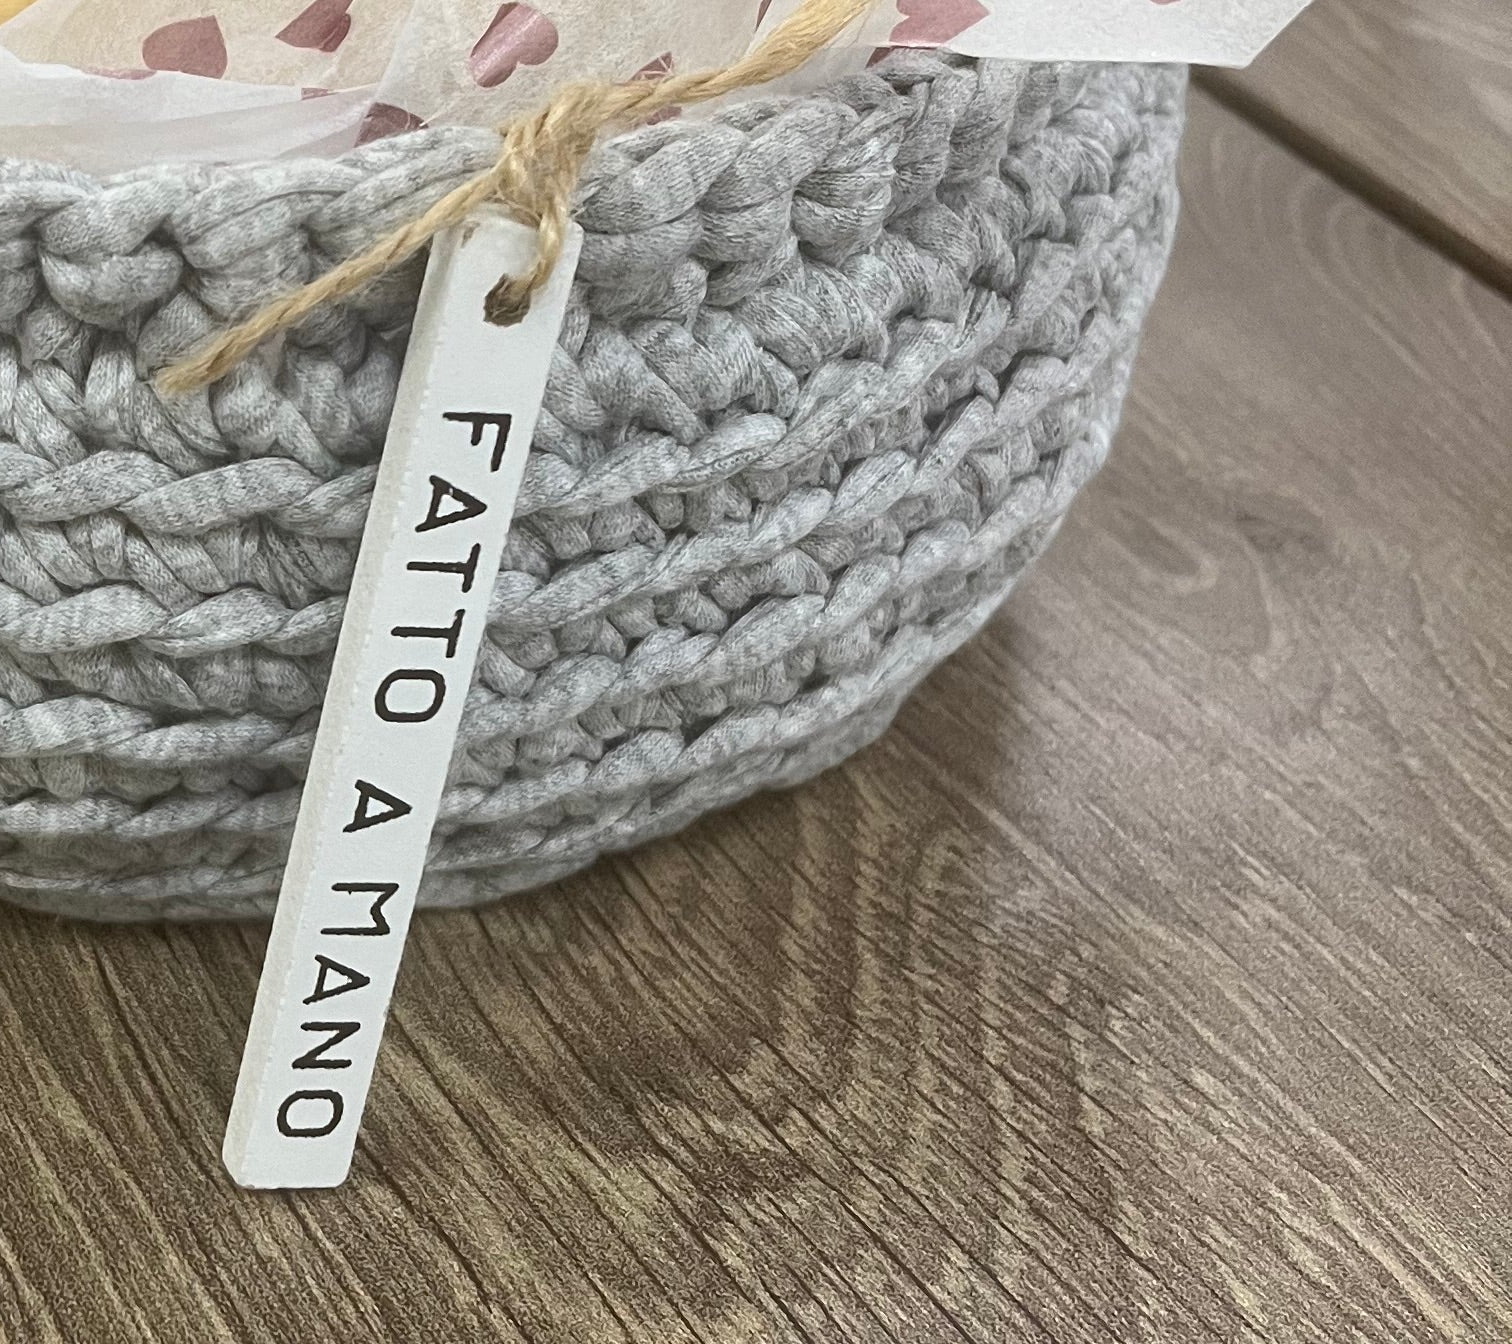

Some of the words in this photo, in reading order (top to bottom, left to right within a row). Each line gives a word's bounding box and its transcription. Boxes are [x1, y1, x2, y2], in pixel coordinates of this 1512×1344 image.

[372, 412, 512, 724] FATTO
[342, 778, 413, 834] A
[276, 881, 400, 1140] MANO
